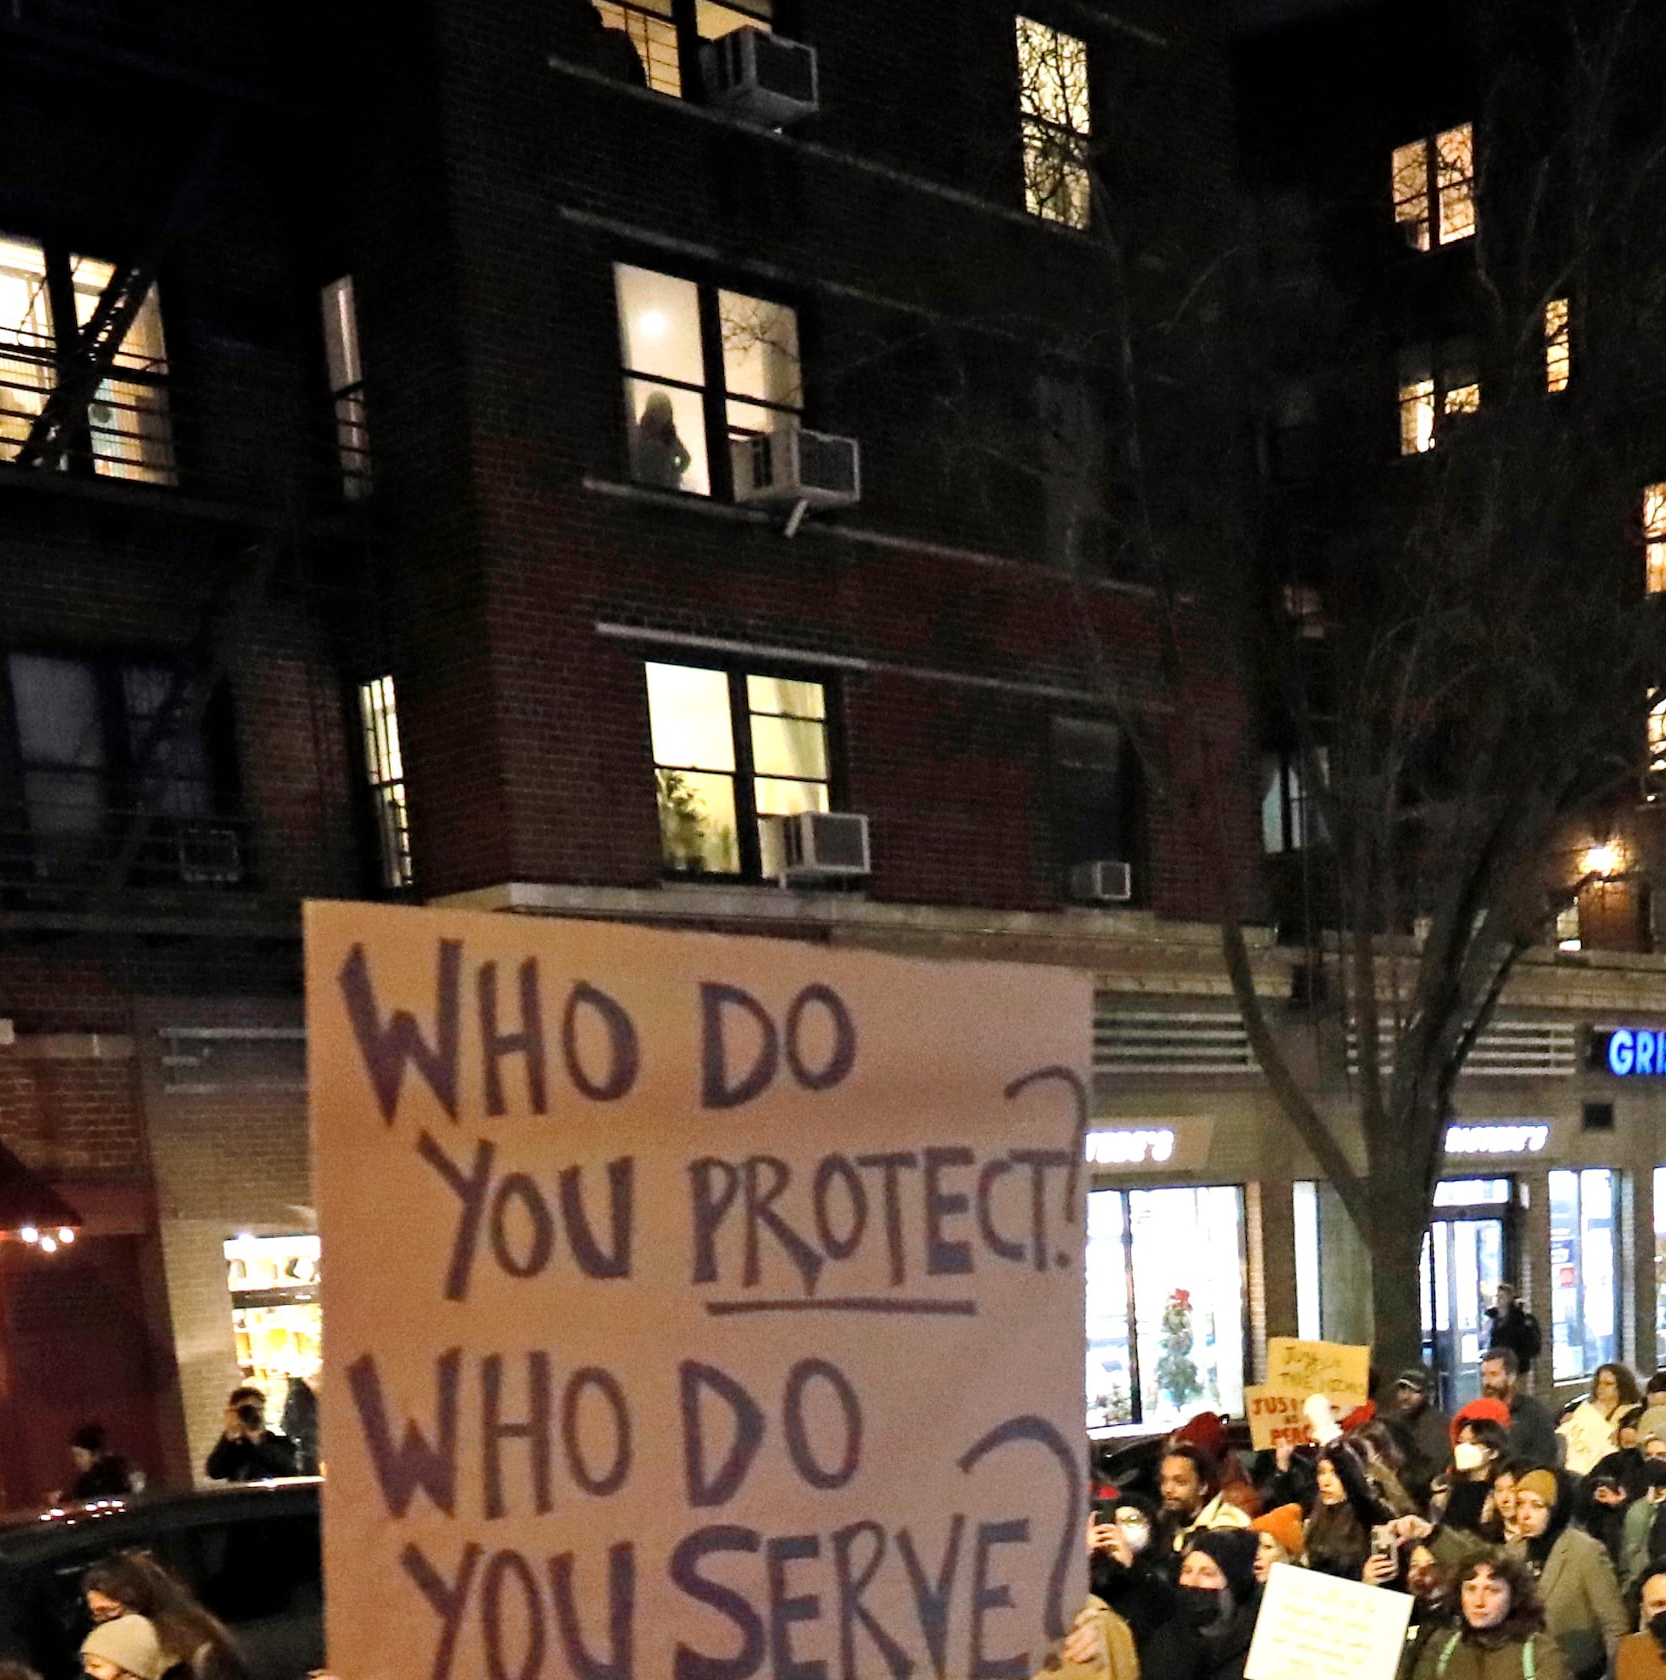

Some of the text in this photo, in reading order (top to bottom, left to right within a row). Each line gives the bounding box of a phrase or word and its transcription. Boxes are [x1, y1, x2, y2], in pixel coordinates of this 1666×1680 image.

[340, 937, 856, 1126] WHO DO
[417, 1065, 1089, 1301] YOU PROTECT?
[347, 1349, 864, 1521] WHO DO
